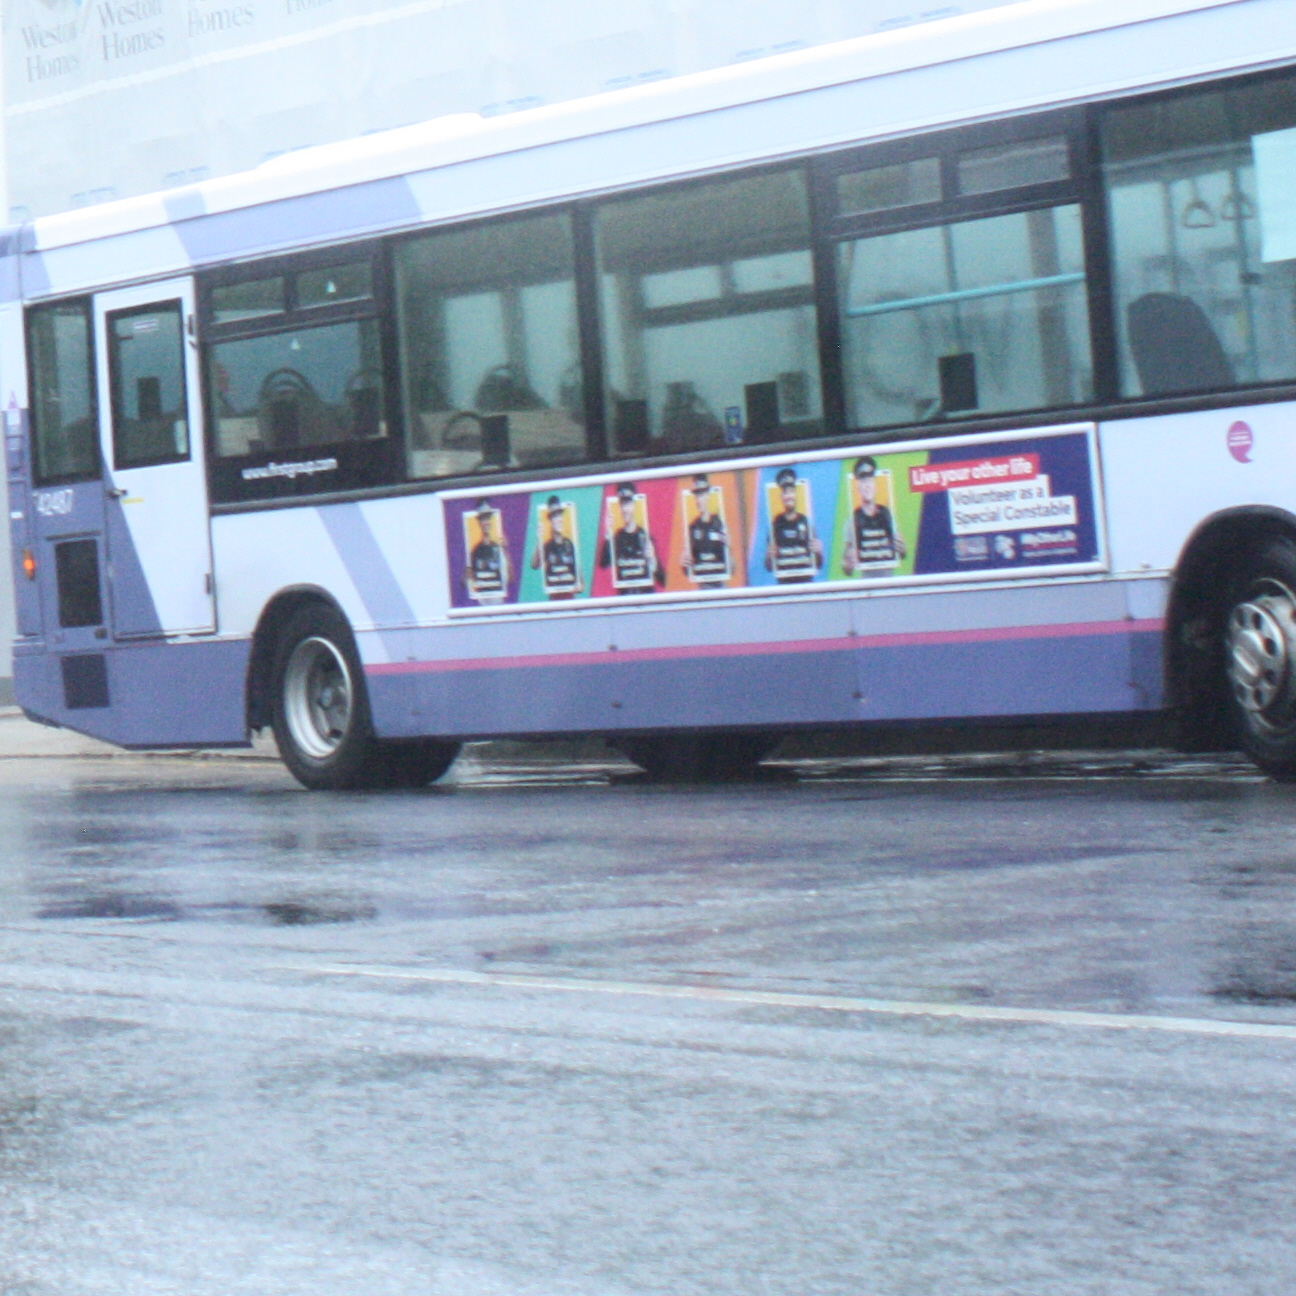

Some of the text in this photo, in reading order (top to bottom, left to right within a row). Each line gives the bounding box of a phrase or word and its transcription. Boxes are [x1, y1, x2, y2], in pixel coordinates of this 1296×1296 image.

[187, 4, 254, 37] Homes
[101, 27, 166, 62] Homes
[911, 457, 1033, 486] Live your other life
[952, 487, 1044, 506] Volunteer as a
[954, 502, 1071, 529] Special Constable
